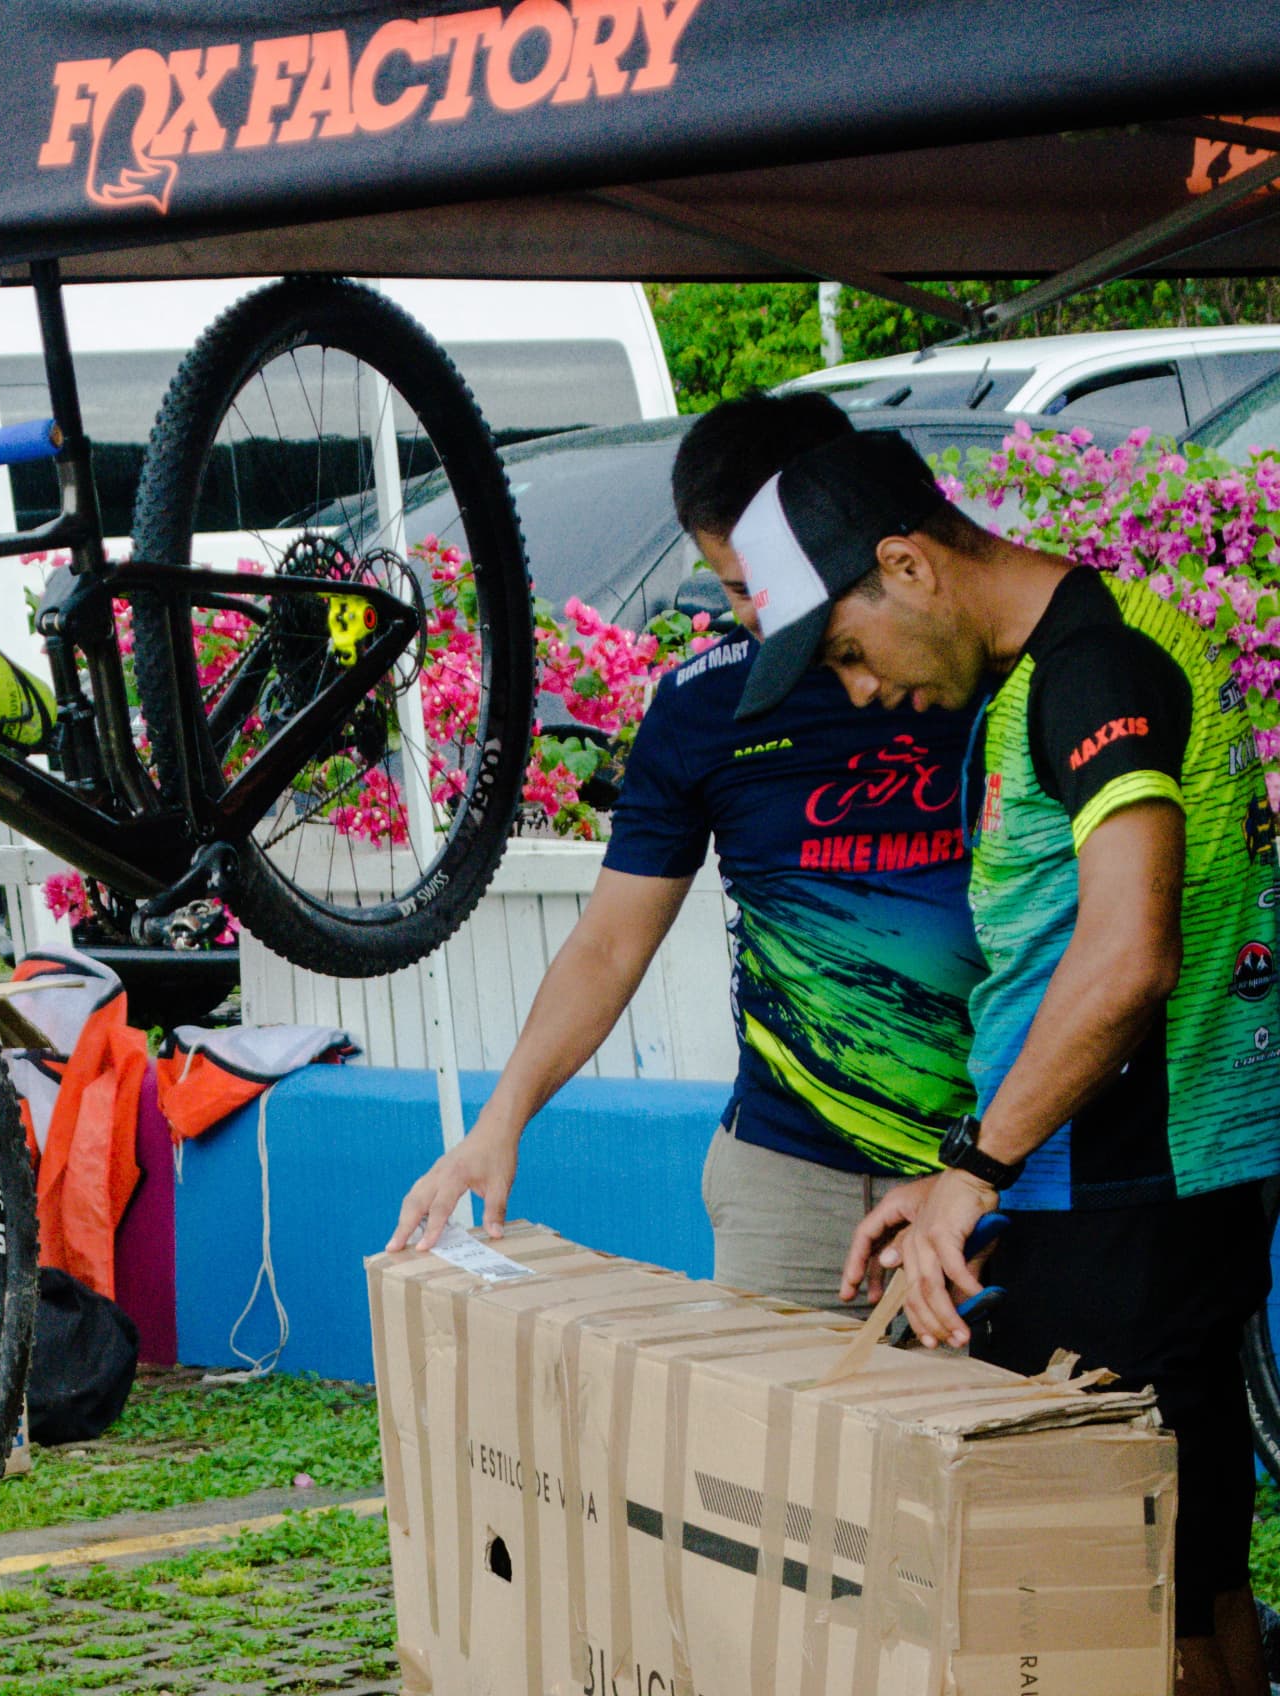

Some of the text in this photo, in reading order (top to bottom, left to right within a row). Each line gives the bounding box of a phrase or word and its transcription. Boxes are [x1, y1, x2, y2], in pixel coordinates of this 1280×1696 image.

[37, 0, 702, 215] FOX FACTORY
[676, 640, 750, 687] BIKE MART
[800, 829, 967, 873] BIKE MART
[416, 869, 450, 906] SWISS
